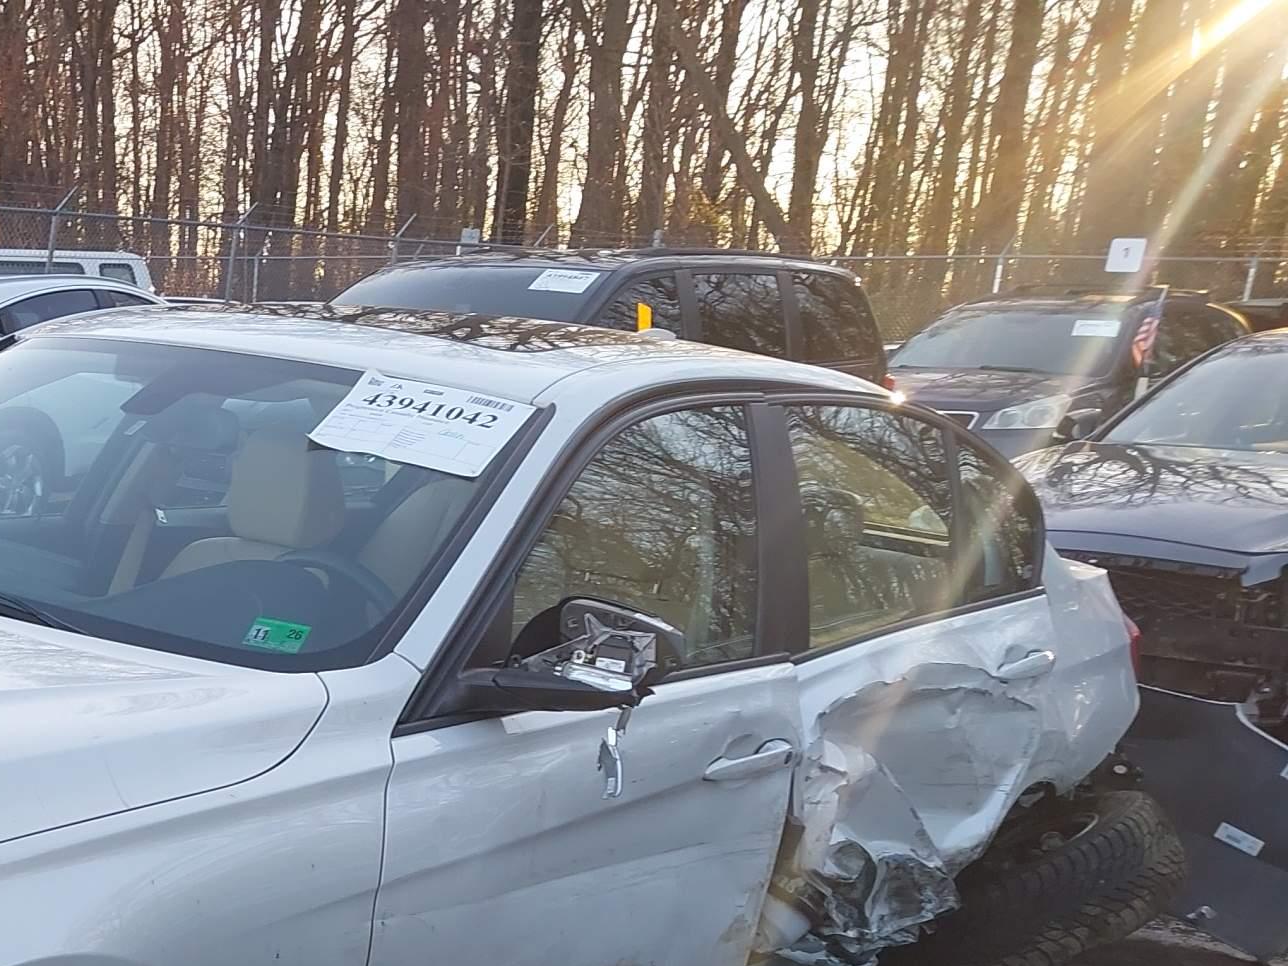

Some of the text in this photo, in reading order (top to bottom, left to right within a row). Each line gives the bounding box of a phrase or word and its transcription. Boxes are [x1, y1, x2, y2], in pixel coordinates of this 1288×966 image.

[362, 392, 498, 429] 43941042
[253, 628, 304, 641] 11 26
